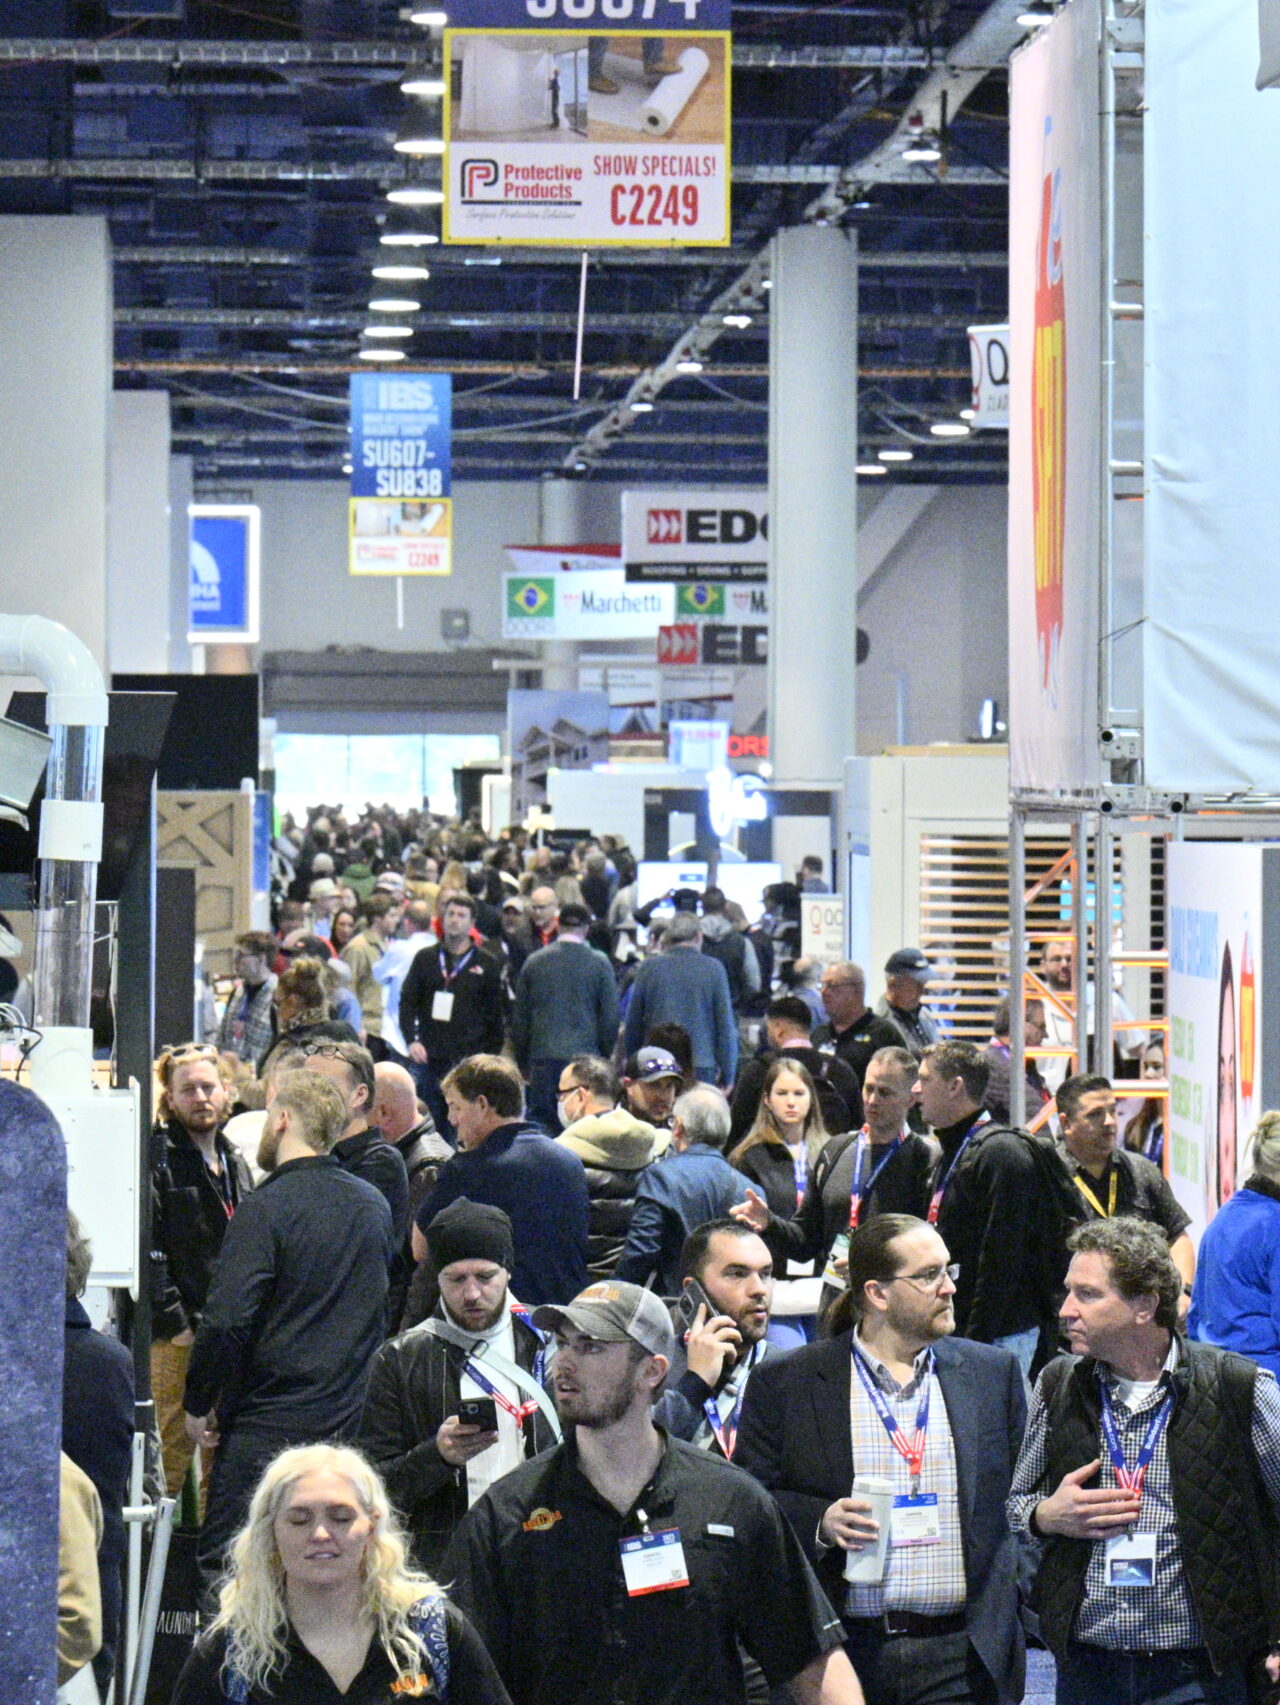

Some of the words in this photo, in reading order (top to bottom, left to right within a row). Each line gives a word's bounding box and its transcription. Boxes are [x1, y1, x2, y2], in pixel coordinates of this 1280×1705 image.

[504, 163, 583, 181] Protective
[593, 156, 637, 176] SHOW
[642, 155, 716, 176] SPECIALS!
[504, 182, 573, 199] Products
[610, 184, 699, 226] C2249
[378, 381, 434, 411] IBS
[363, 439, 436, 467] SU607-
[376, 468, 443, 497] SU838
[686, 510, 768, 544] ED
[581, 588, 662, 614] Marchetti
